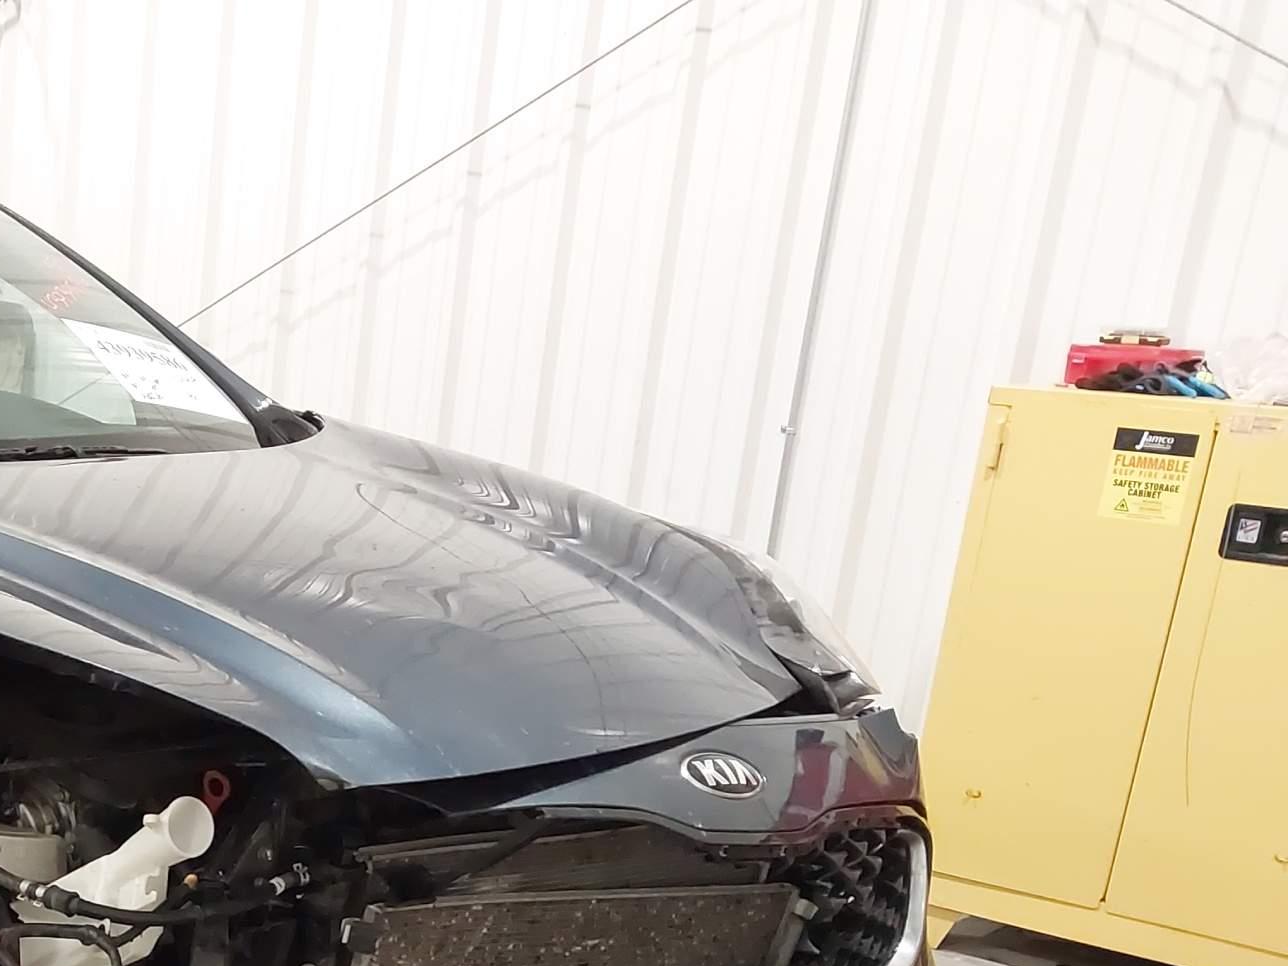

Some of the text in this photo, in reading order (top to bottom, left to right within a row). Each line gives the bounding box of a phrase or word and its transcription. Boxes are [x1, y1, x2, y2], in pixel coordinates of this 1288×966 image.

[1135, 431, 1174, 450] Jamco
[1114, 454, 1190, 473] FLAMMABLE
[1112, 478, 1180, 494] SAFETY STORAGE
[1128, 488, 1162, 499] CABINET
[692, 759, 758, 787] KIA
